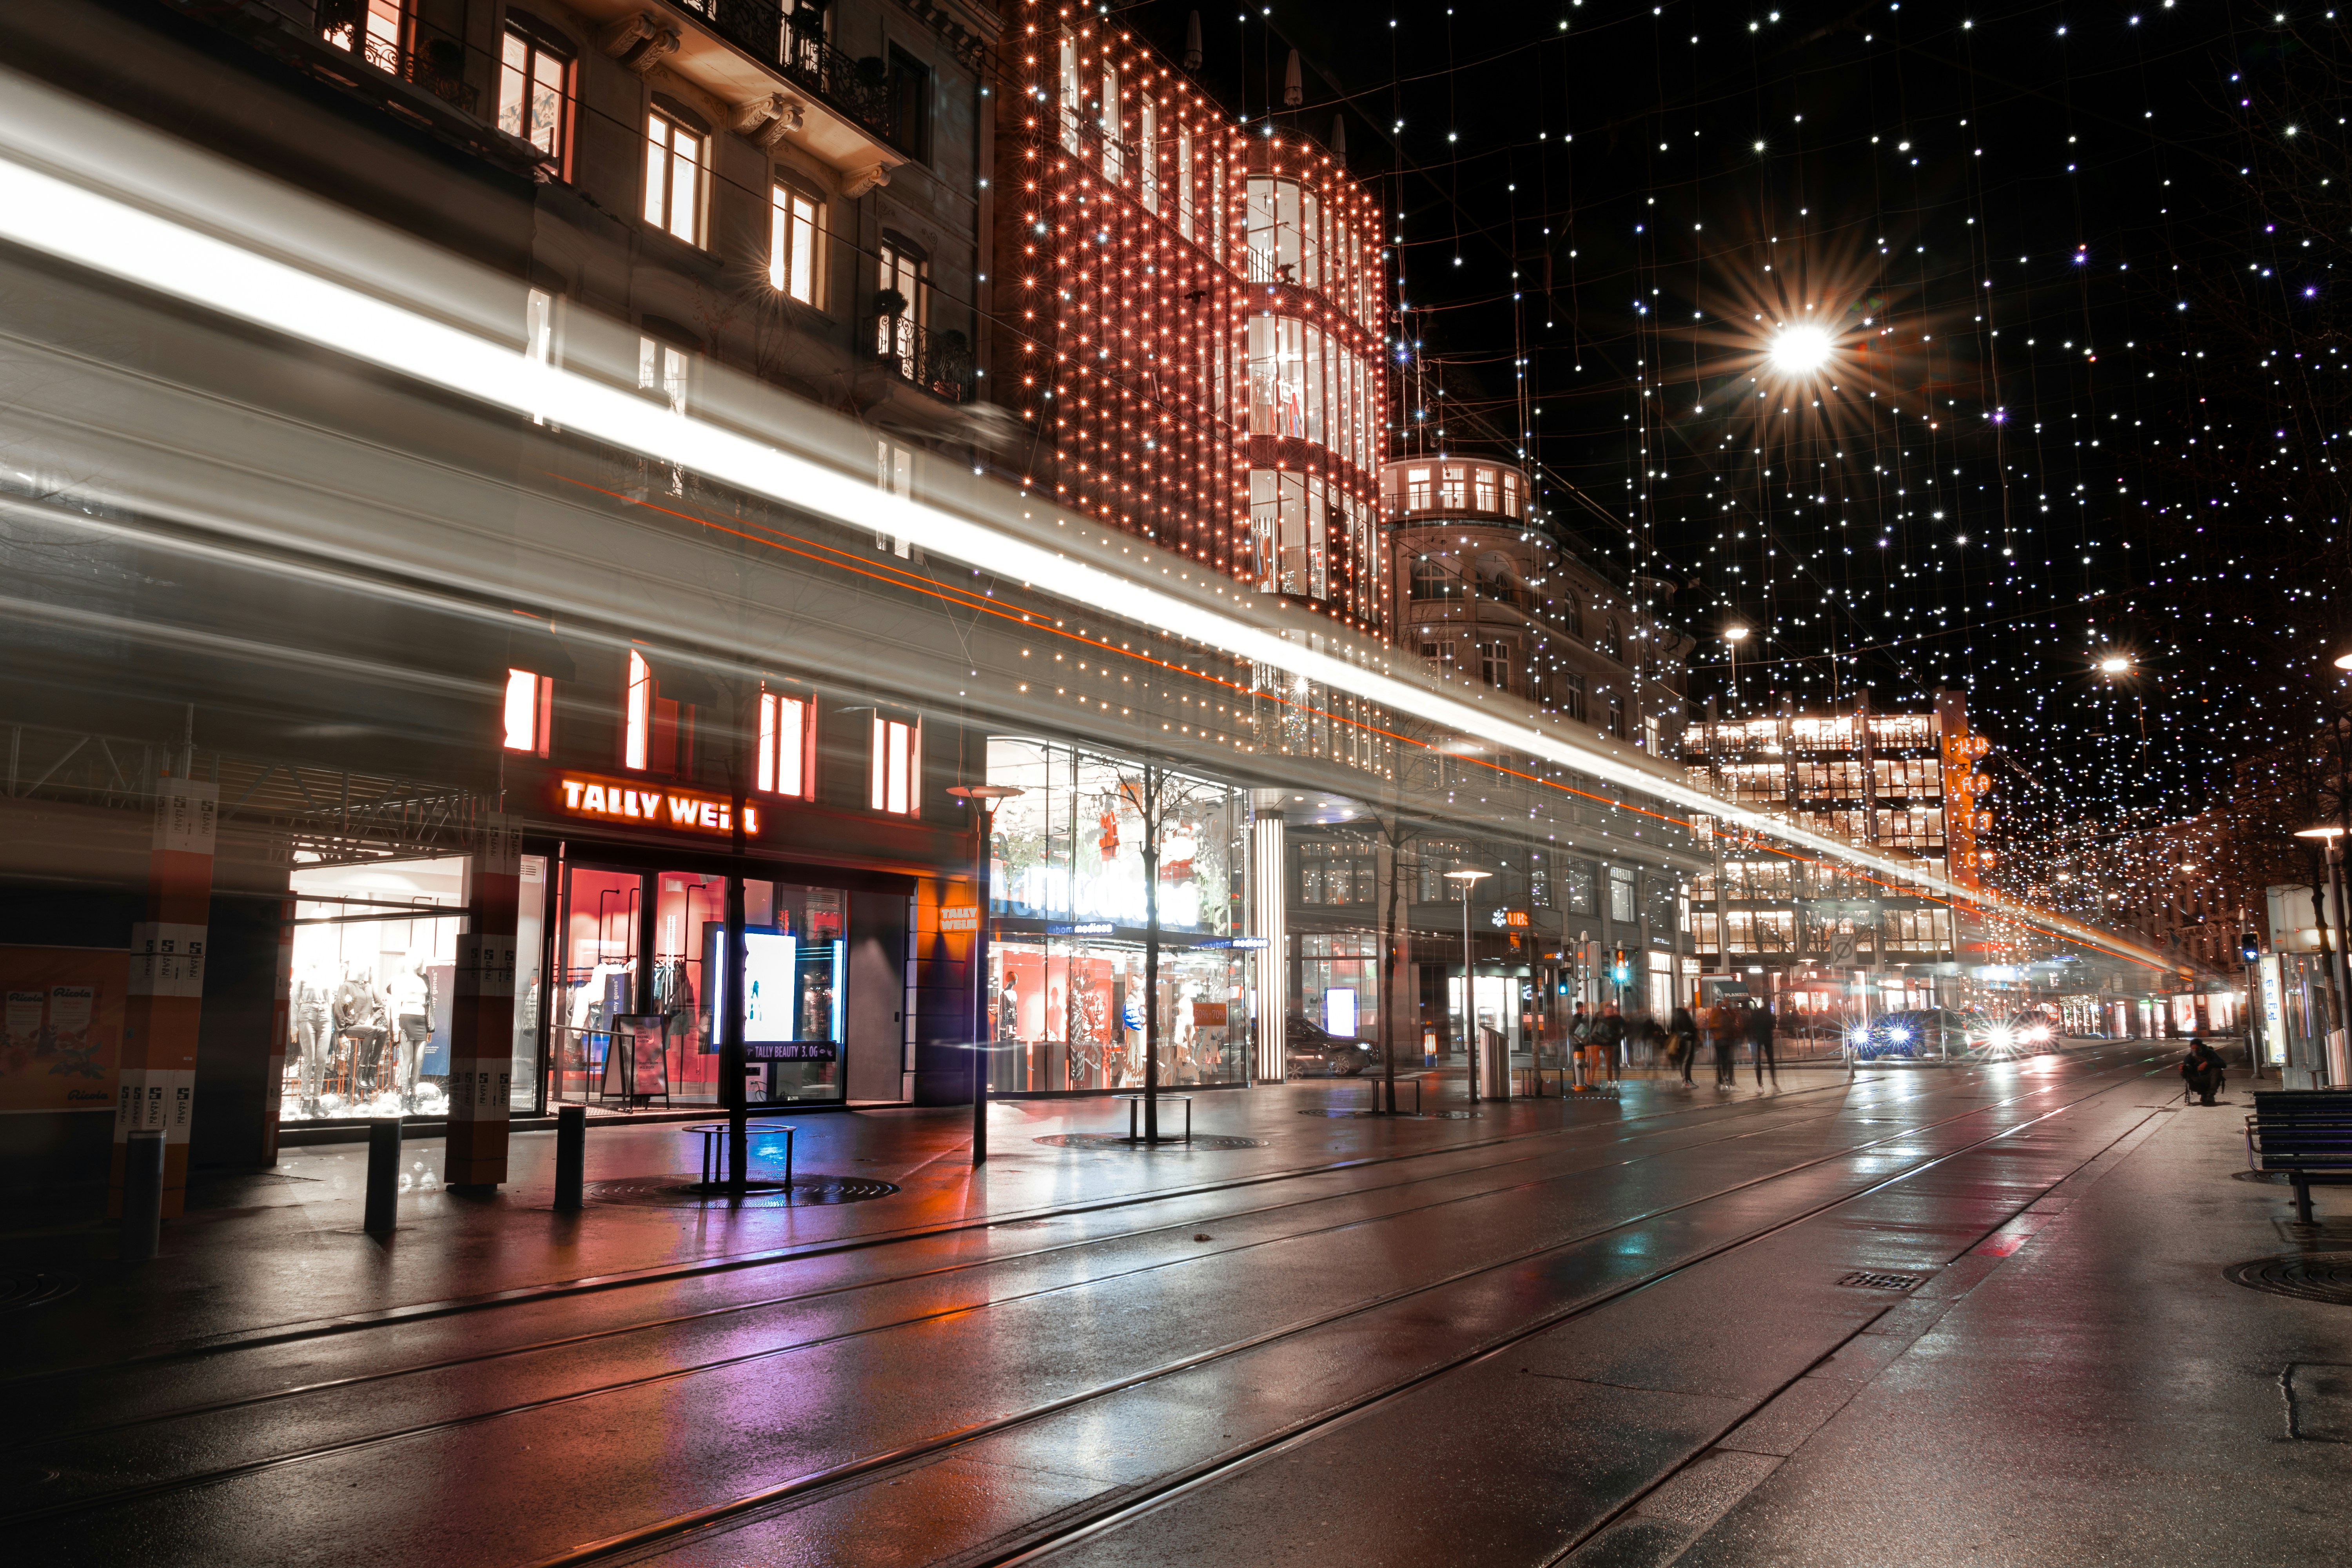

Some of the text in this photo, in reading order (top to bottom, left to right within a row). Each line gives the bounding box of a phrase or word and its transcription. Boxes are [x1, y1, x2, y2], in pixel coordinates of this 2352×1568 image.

[562, 780, 759, 833] TALLY WEiL
[941, 908, 977, 918] TALLY
[9, 993, 44, 1002] Ricola
[53, 987, 91, 998] Ricola
[613, 1001, 619, 1011] my
[755, 1046, 818, 1057] TALLY BEAUTY 3. OG
[67, 1089, 109, 1100] Ricola
